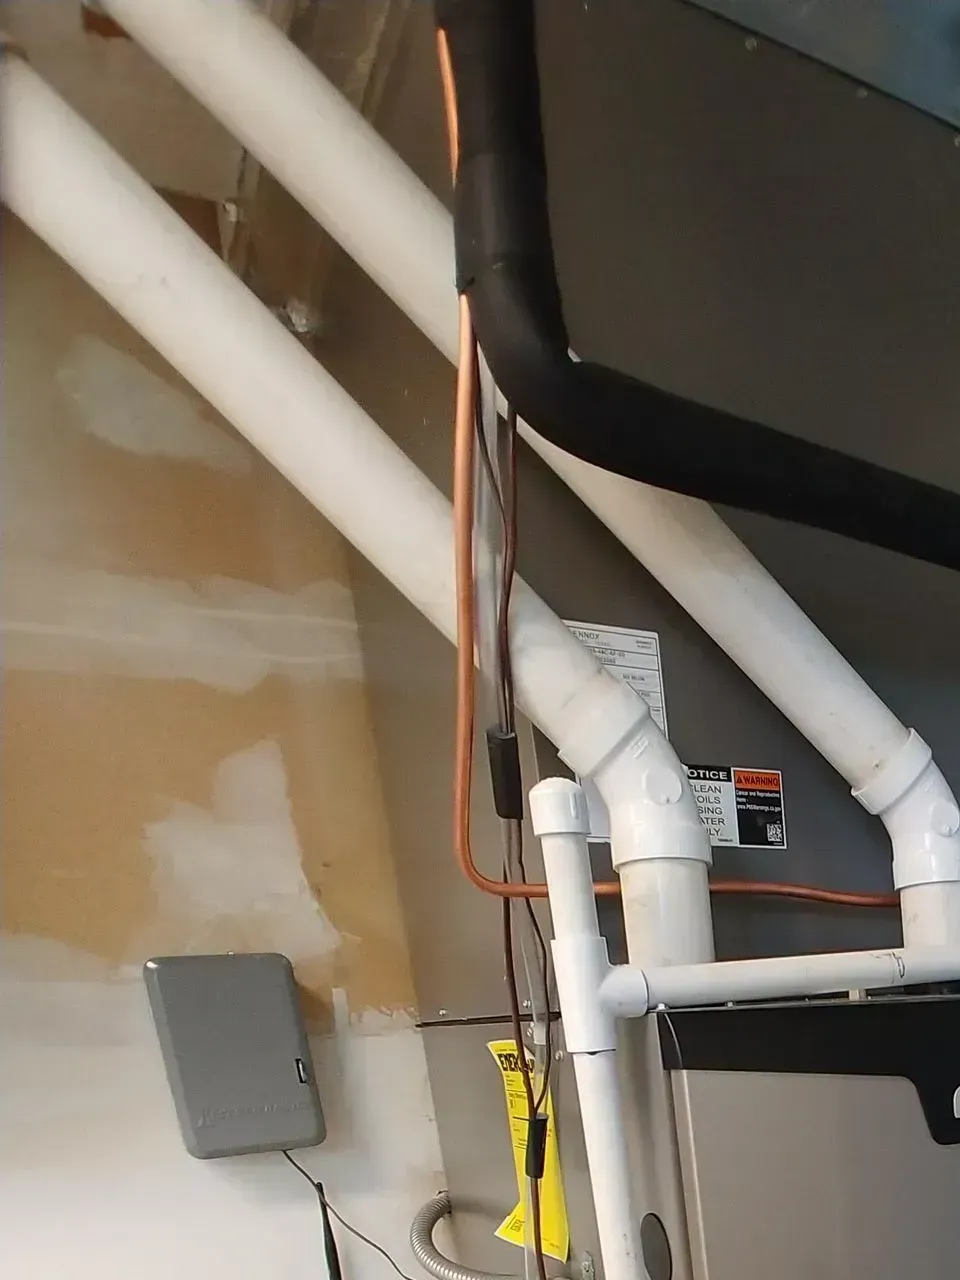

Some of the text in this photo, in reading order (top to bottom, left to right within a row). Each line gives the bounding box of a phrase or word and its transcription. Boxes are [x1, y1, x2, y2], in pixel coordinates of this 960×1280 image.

[571, 630, 600, 640] ENNOX
[687, 768, 728, 780] OTICE
[742, 775, 779, 787] WARNING
[694, 784, 722, 794] LEAN
[696, 795, 722, 805] OILS
[698, 806, 723, 816] SING
[700, 817, 726, 826] ATER
